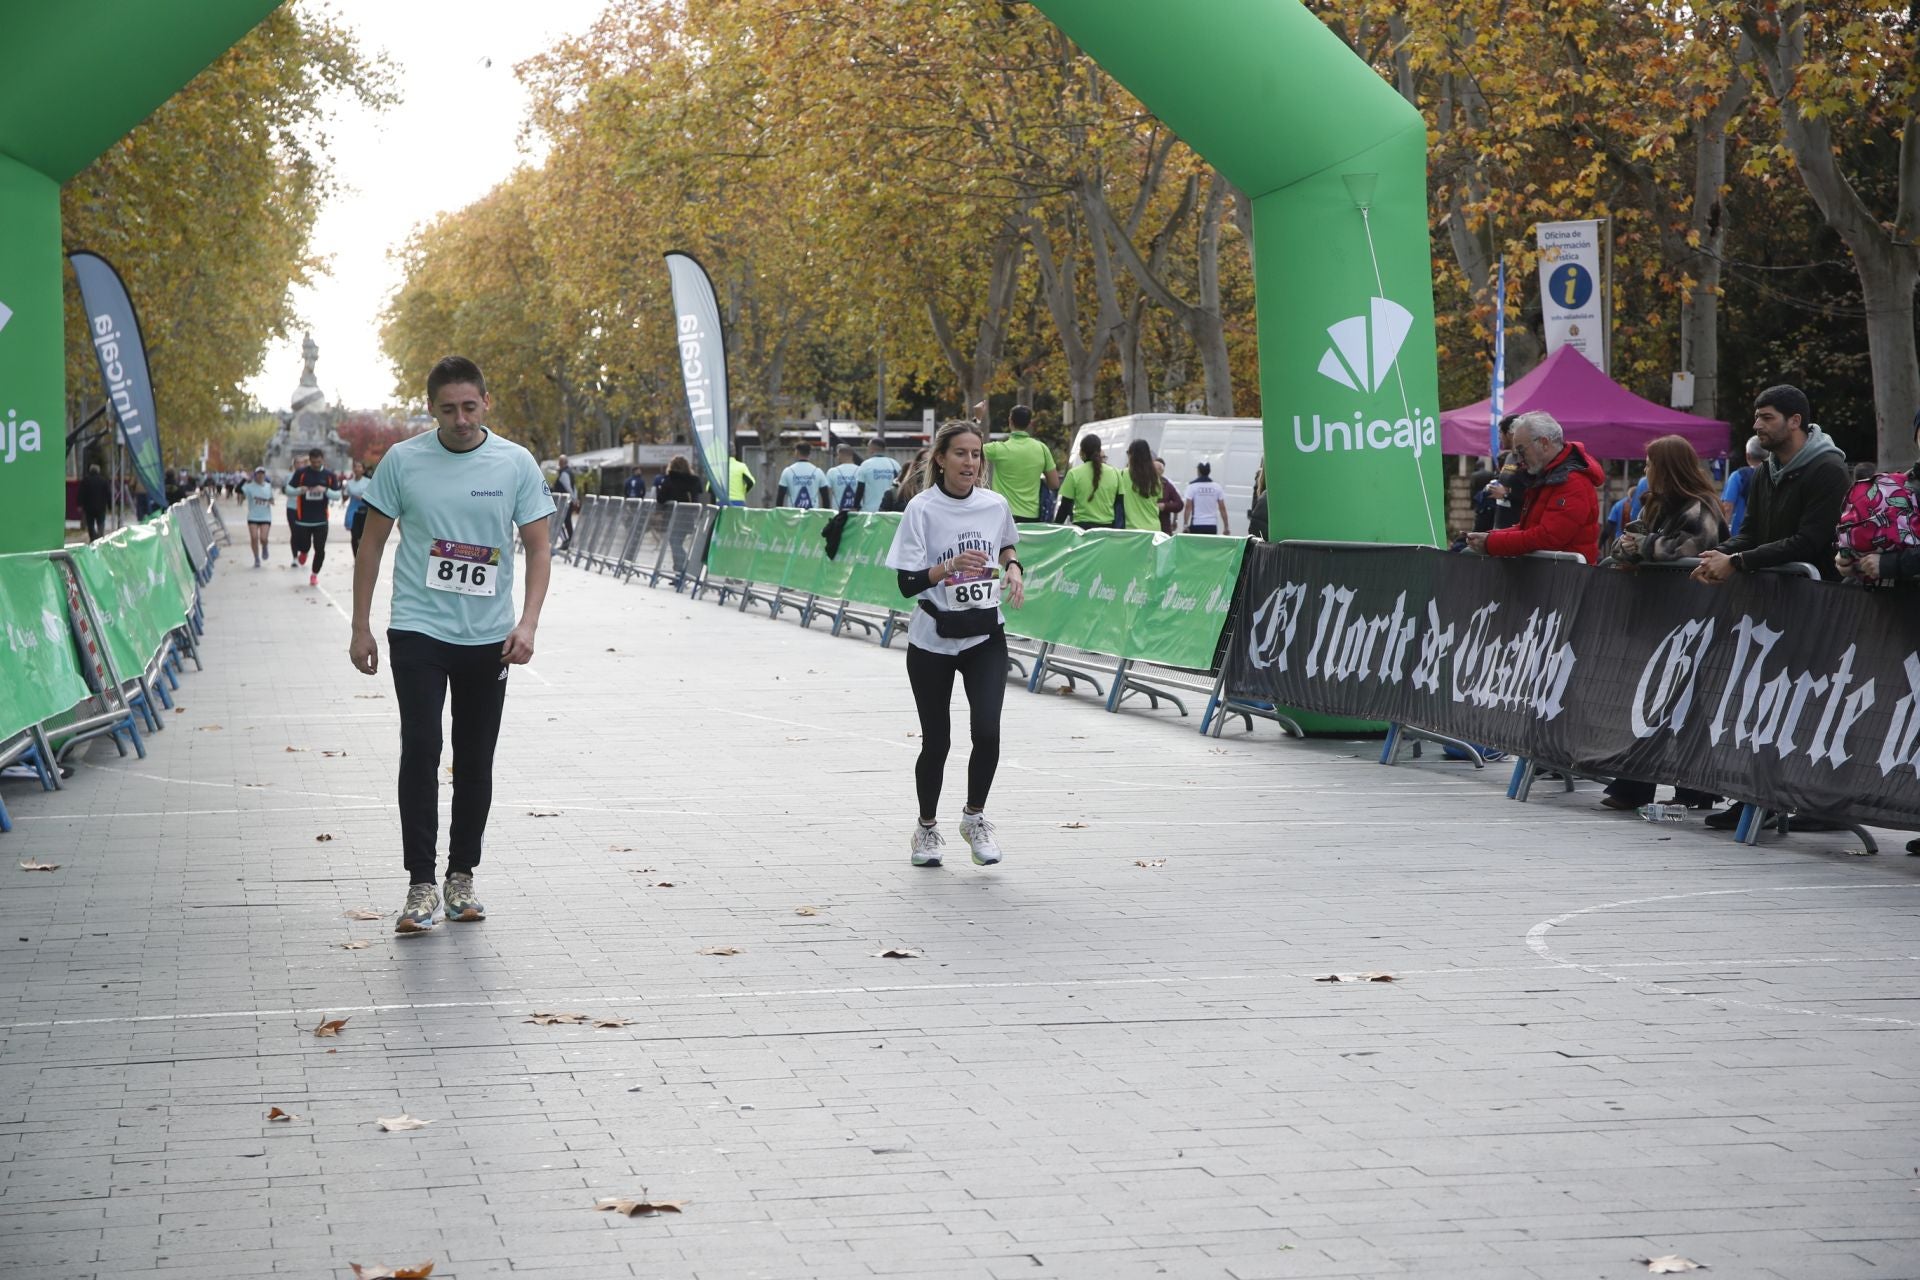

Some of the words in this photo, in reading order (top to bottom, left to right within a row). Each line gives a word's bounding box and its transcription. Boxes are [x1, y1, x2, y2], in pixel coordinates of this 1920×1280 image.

[1545, 231, 1571, 240] Oficina
[1572, 230, 1582, 238] de
[0, 409, 41, 464] ja
[1294, 407, 1436, 459] Unicaja
[957, 531, 982, 541] HOSPITAL
[437, 560, 487, 586] 816
[955, 582, 993, 603] 867
[1249, 581, 1307, 673] El
[1306, 583, 1416, 686] Norte
[1631, 616, 1715, 738] El
[1709, 614, 1875, 770] Norte
